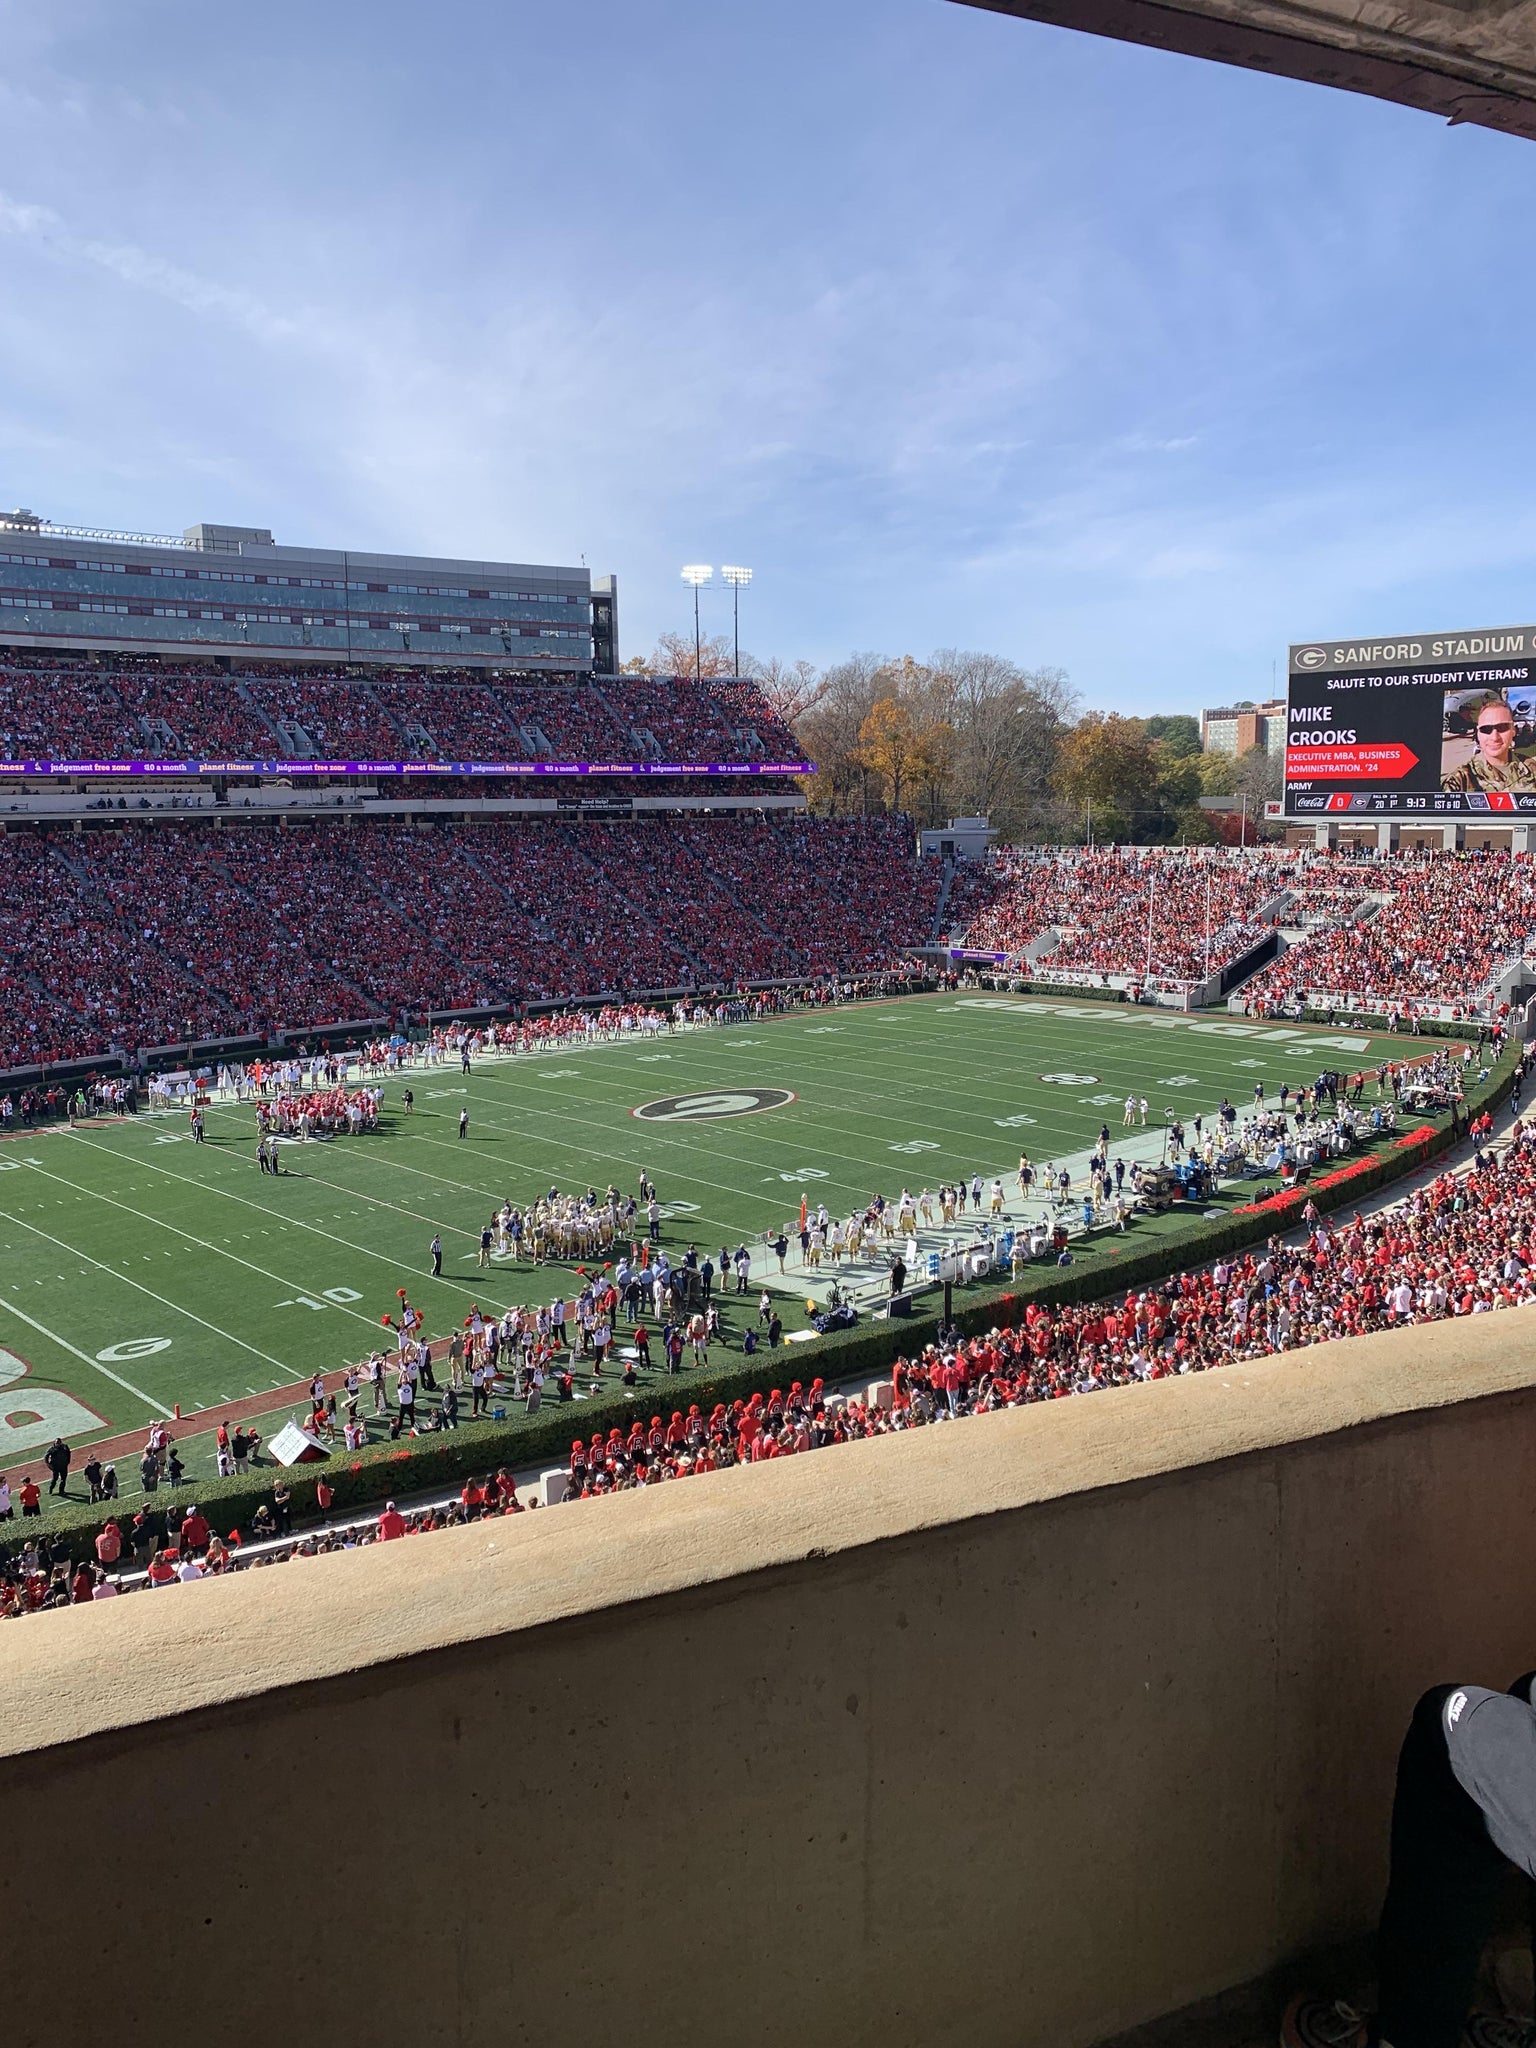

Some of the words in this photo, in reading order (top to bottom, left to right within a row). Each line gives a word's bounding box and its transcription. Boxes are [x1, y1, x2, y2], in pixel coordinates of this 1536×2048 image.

[1334, 643, 1422, 664] SANFORD
[1431, 635, 1524, 657] STADIUM
[1327, 678, 1365, 690] SALUTE
[1368, 677, 1382, 688] TO
[1385, 675, 1409, 687] OUR
[1411, 671, 1464, 685] STUDENT
[1466, 668, 1528, 681] VETERANS
[1290, 706, 1333, 722] MIKE
[1289, 729, 1357, 746] CROOKS
[1288, 752, 1332, 761] EXECUTIVE
[1334, 751, 1356, 761] MBA,
[1359, 750, 1400, 760] BUSINESS
[50, 763, 93, 772] judgement
[94, 763, 110, 771] free
[163, 763, 187, 771] month
[199, 762, 225, 772] planet
[226, 762, 254, 771] fitness
[276, 763, 312, 772] judgement
[314, 763, 328, 771] free
[403, 764, 426, 772] planet
[427, 763, 452, 771] fitness
[1286, 782, 1313, 790] ARMY
[1337, 797, 1344, 807] 0
[1375, 800, 1385, 808] 20
[1406, 798, 1426, 808] 9:13
[1497, 796, 1504, 807] 7
[955, 998, 1372, 1053] GEORGIA
[887, 1140, 942, 1154] 50
[779, 1167, 830, 1182] 40
[295, 1287, 364, 1311] 10
[96, 1337, 172, 1362] G
